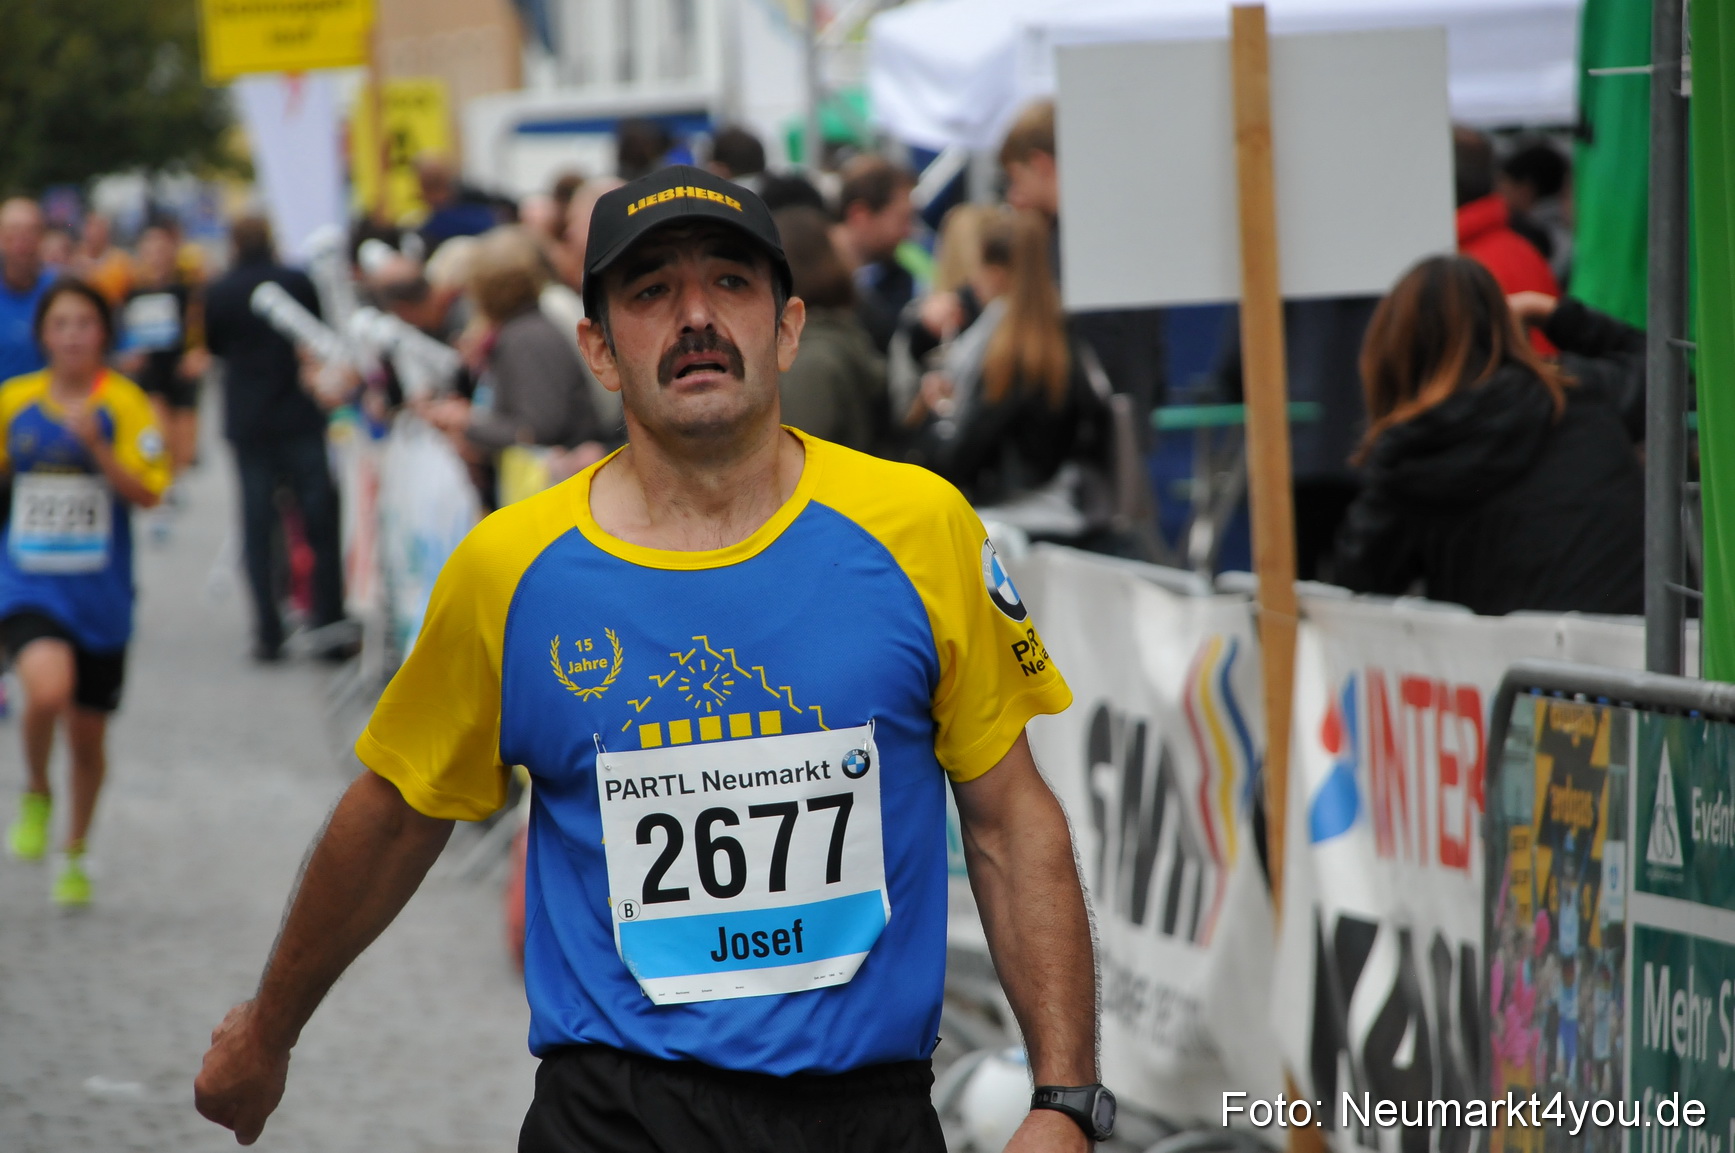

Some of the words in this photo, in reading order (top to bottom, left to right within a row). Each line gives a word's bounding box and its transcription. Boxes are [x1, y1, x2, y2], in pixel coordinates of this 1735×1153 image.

[627, 185, 743, 216] LIEBHERR
[575, 638, 593, 652] 15
[568, 658, 608, 674] Jahre
[605, 774, 695, 801] PARTL
[702, 760, 831, 793] Neumarkt
[635, 792, 855, 906] 2677
[623, 903, 634, 918] B
[710, 919, 804, 963] Josef
[1643, 961, 1712, 1063] Mehr
